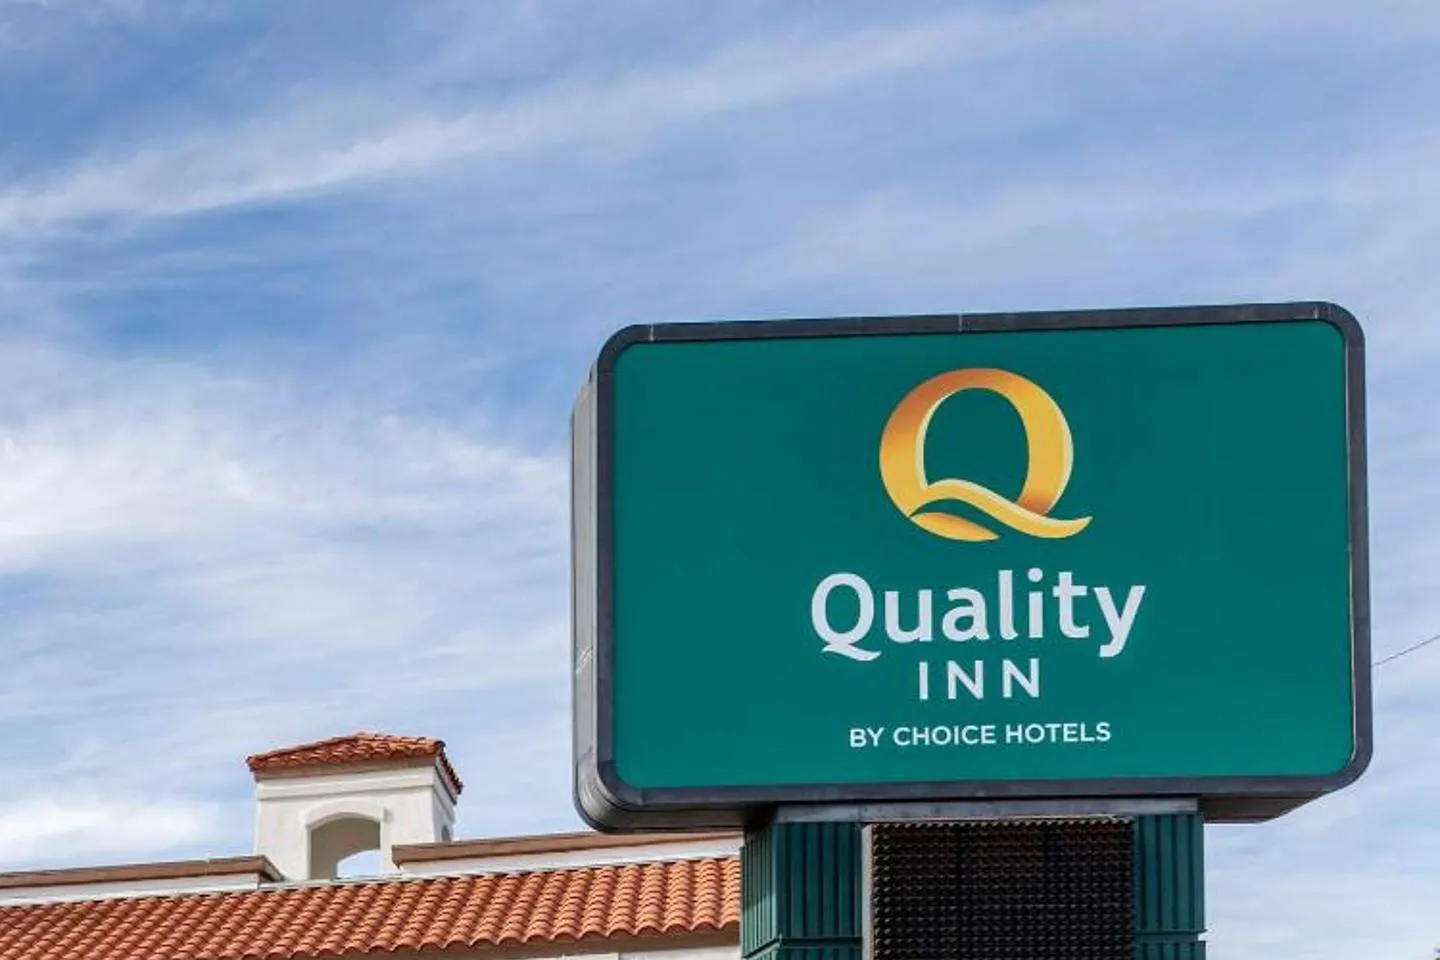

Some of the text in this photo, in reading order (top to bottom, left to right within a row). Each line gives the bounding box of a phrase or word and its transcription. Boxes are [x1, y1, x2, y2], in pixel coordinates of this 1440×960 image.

[811, 567, 1147, 661] Quality
[918, 658, 1040, 701] INN
[849, 722, 1112, 747] BY CHOICE HOTELS
